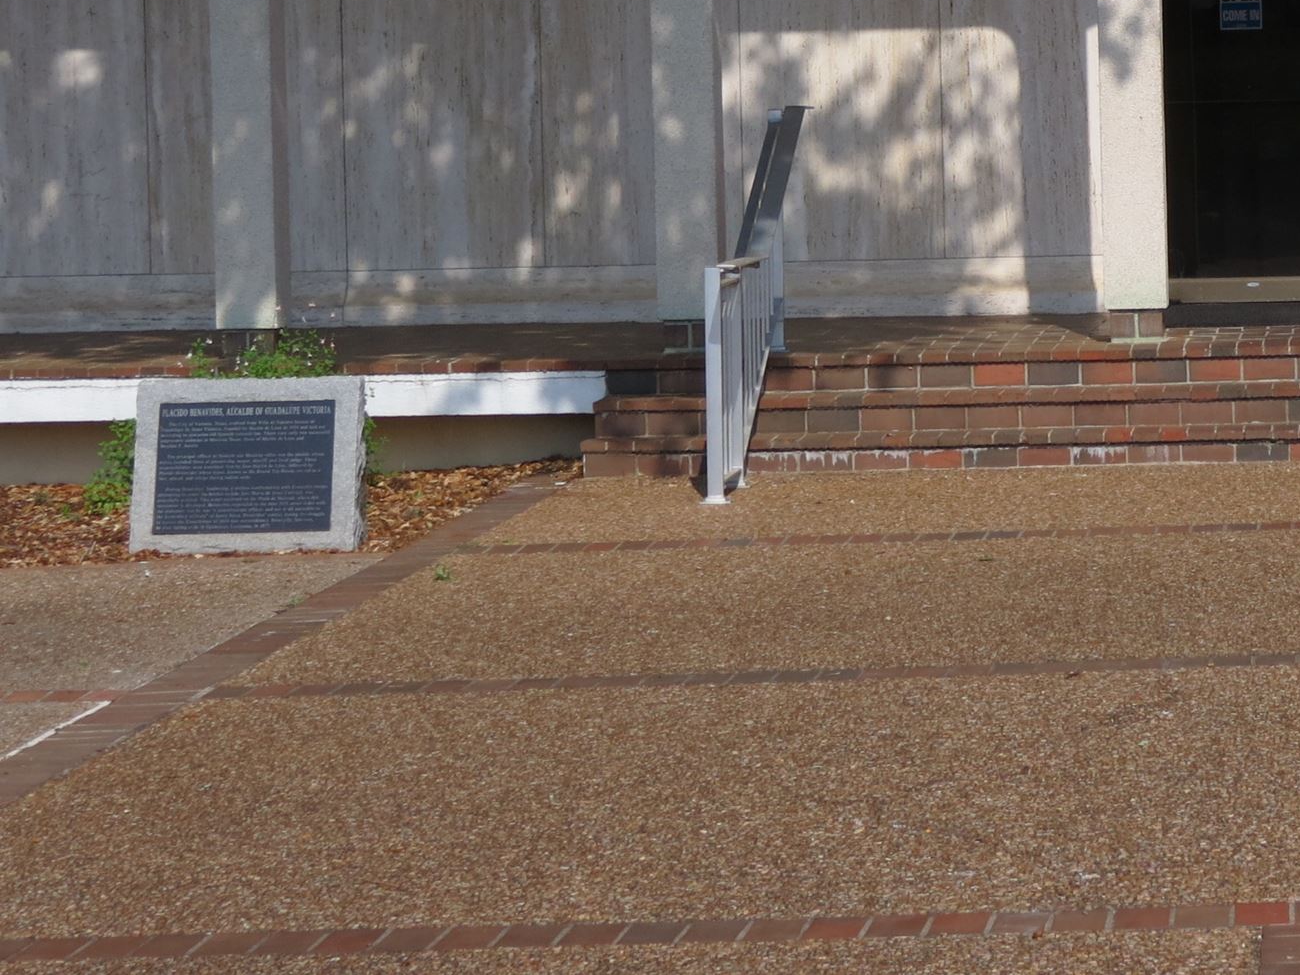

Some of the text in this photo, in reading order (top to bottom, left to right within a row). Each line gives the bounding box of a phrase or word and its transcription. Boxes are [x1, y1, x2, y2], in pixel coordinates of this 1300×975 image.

[1223, 9, 1260, 21] COME IN
[255, 407, 263, 415] OF
[264, 406, 300, 415] GUADALUPE
[302, 405, 331, 414] VICTORIA
